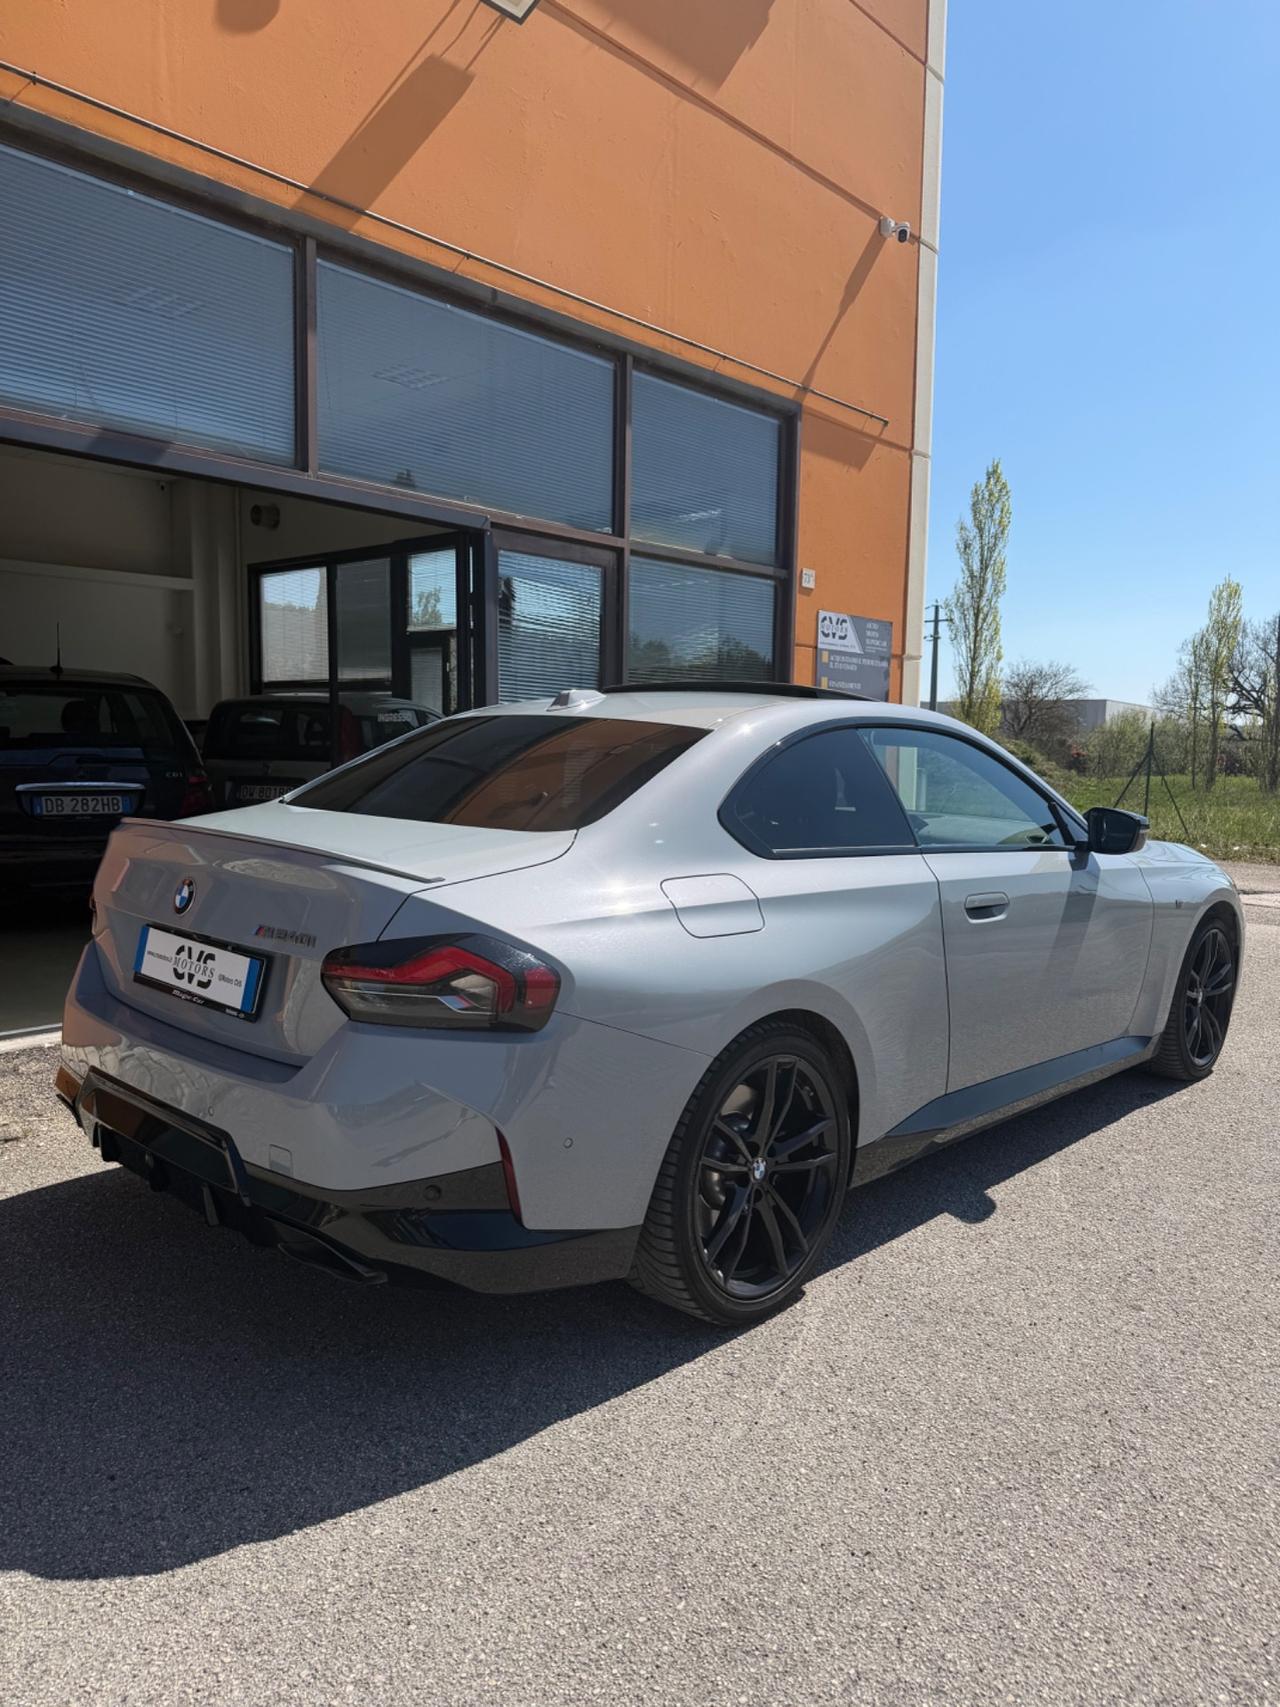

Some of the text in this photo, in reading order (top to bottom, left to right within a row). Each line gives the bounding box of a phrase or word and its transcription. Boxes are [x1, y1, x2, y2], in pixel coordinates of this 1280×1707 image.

[44, 796, 121, 814] DB 282HB
[173, 945, 216, 989] CVS
[173, 956, 216, 979] MOTORS
